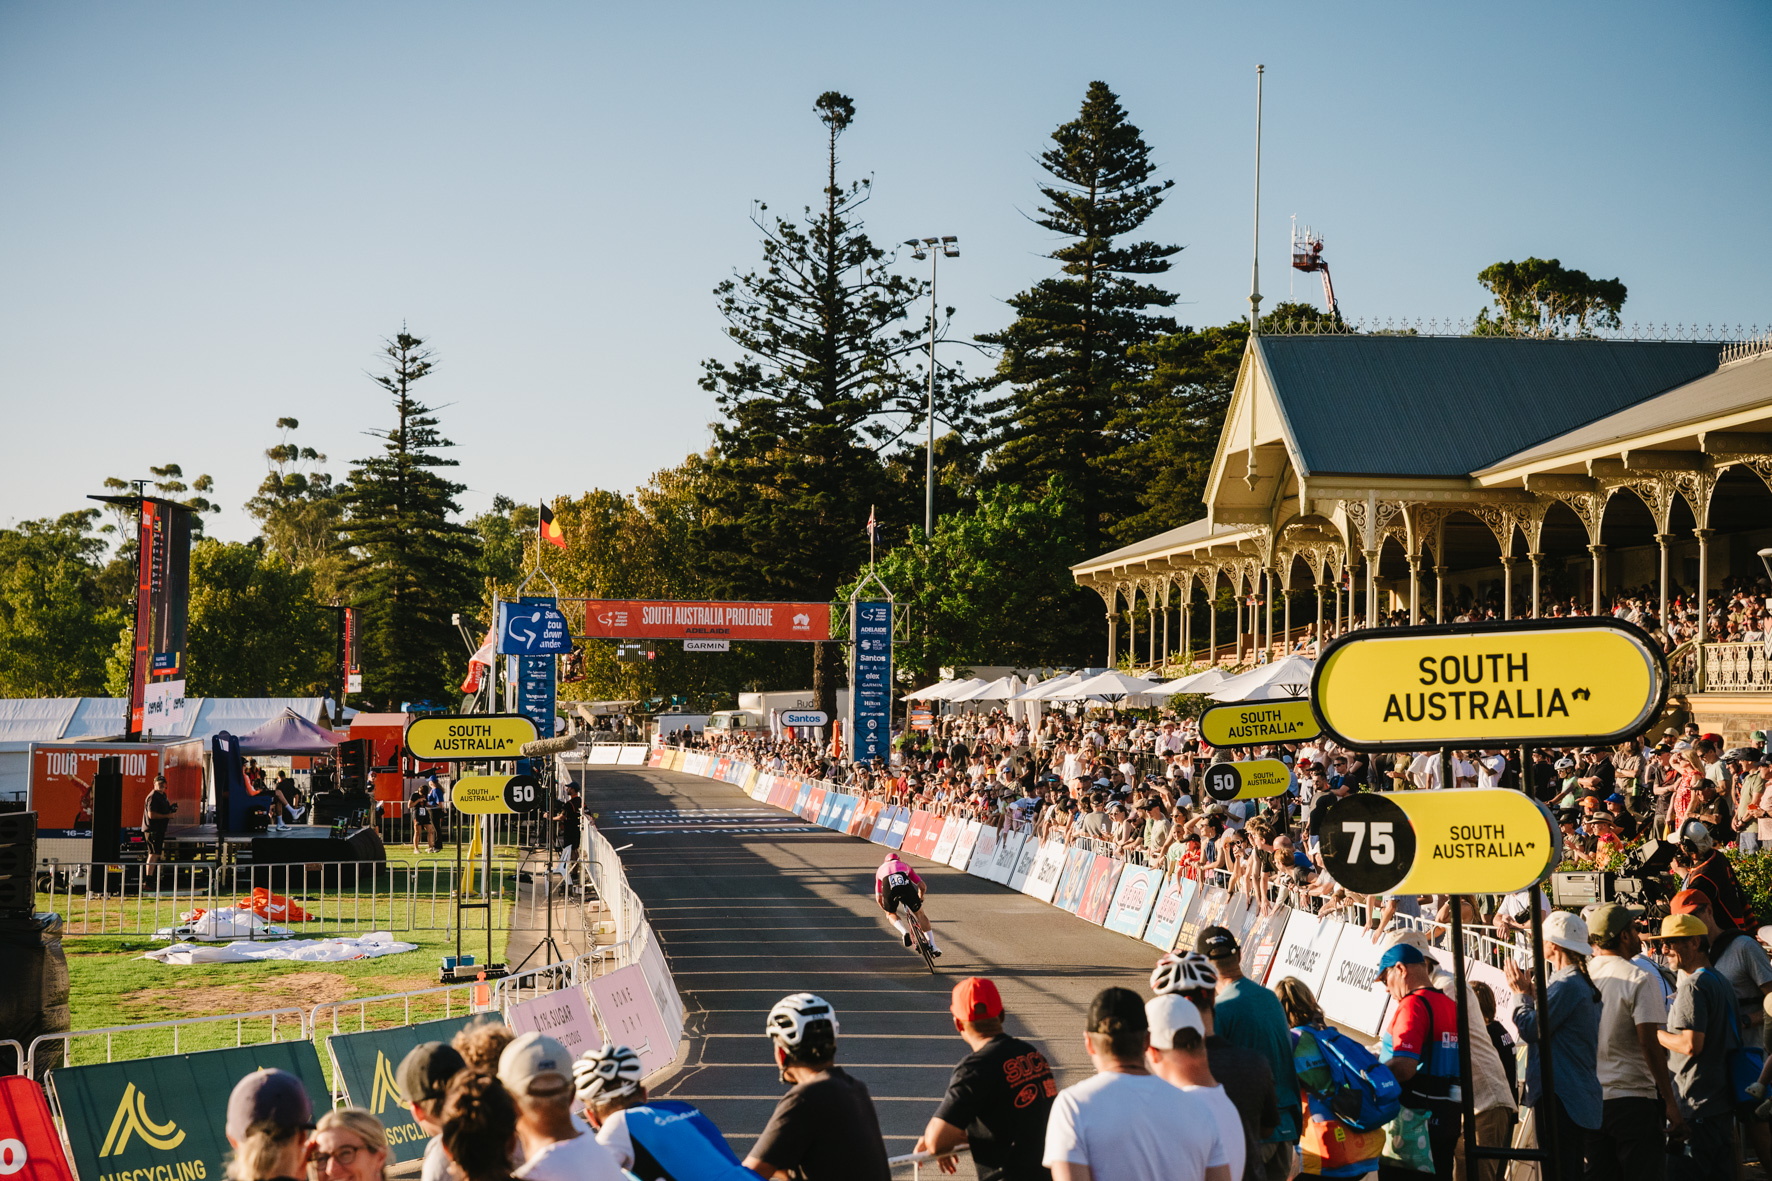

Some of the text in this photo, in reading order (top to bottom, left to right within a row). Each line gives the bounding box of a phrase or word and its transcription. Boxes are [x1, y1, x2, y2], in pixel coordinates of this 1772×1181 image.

[642, 606, 773, 626] SOUTH AUSTRALIA PROLOGUE
[686, 627, 730, 635] ADELAIDE
[1419, 653, 1528, 686] SOUTH
[1383, 688, 1569, 722] AUSTRALIA
[789, 715, 821, 723] Santos
[1240, 710, 1282, 724] SOUTH
[449, 725, 491, 736] SOUTH
[1228, 722, 1296, 738] AUSTRALIA
[434, 739, 506, 750] AUSTRALIA
[46, 753, 78, 776] TOUR
[1213, 773, 1235, 790] 50
[1247, 778, 1281, 786] AUSTRALIA
[1253, 771, 1274, 779] SOUTH
[467, 788, 489, 796] SOUTH
[513, 785, 535, 803] 50
[1450, 825, 1504, 840] SOUTH
[1341, 822, 1395, 865] 75
[1433, 841, 1525, 859] AUSTRALIA
[1284, 944, 1318, 973] SCHWALBE
[612, 987, 633, 1008] BONE
[533, 1004, 575, 1032] 0.1% SUGAR
[622, 1013, 643, 1034] DRY
